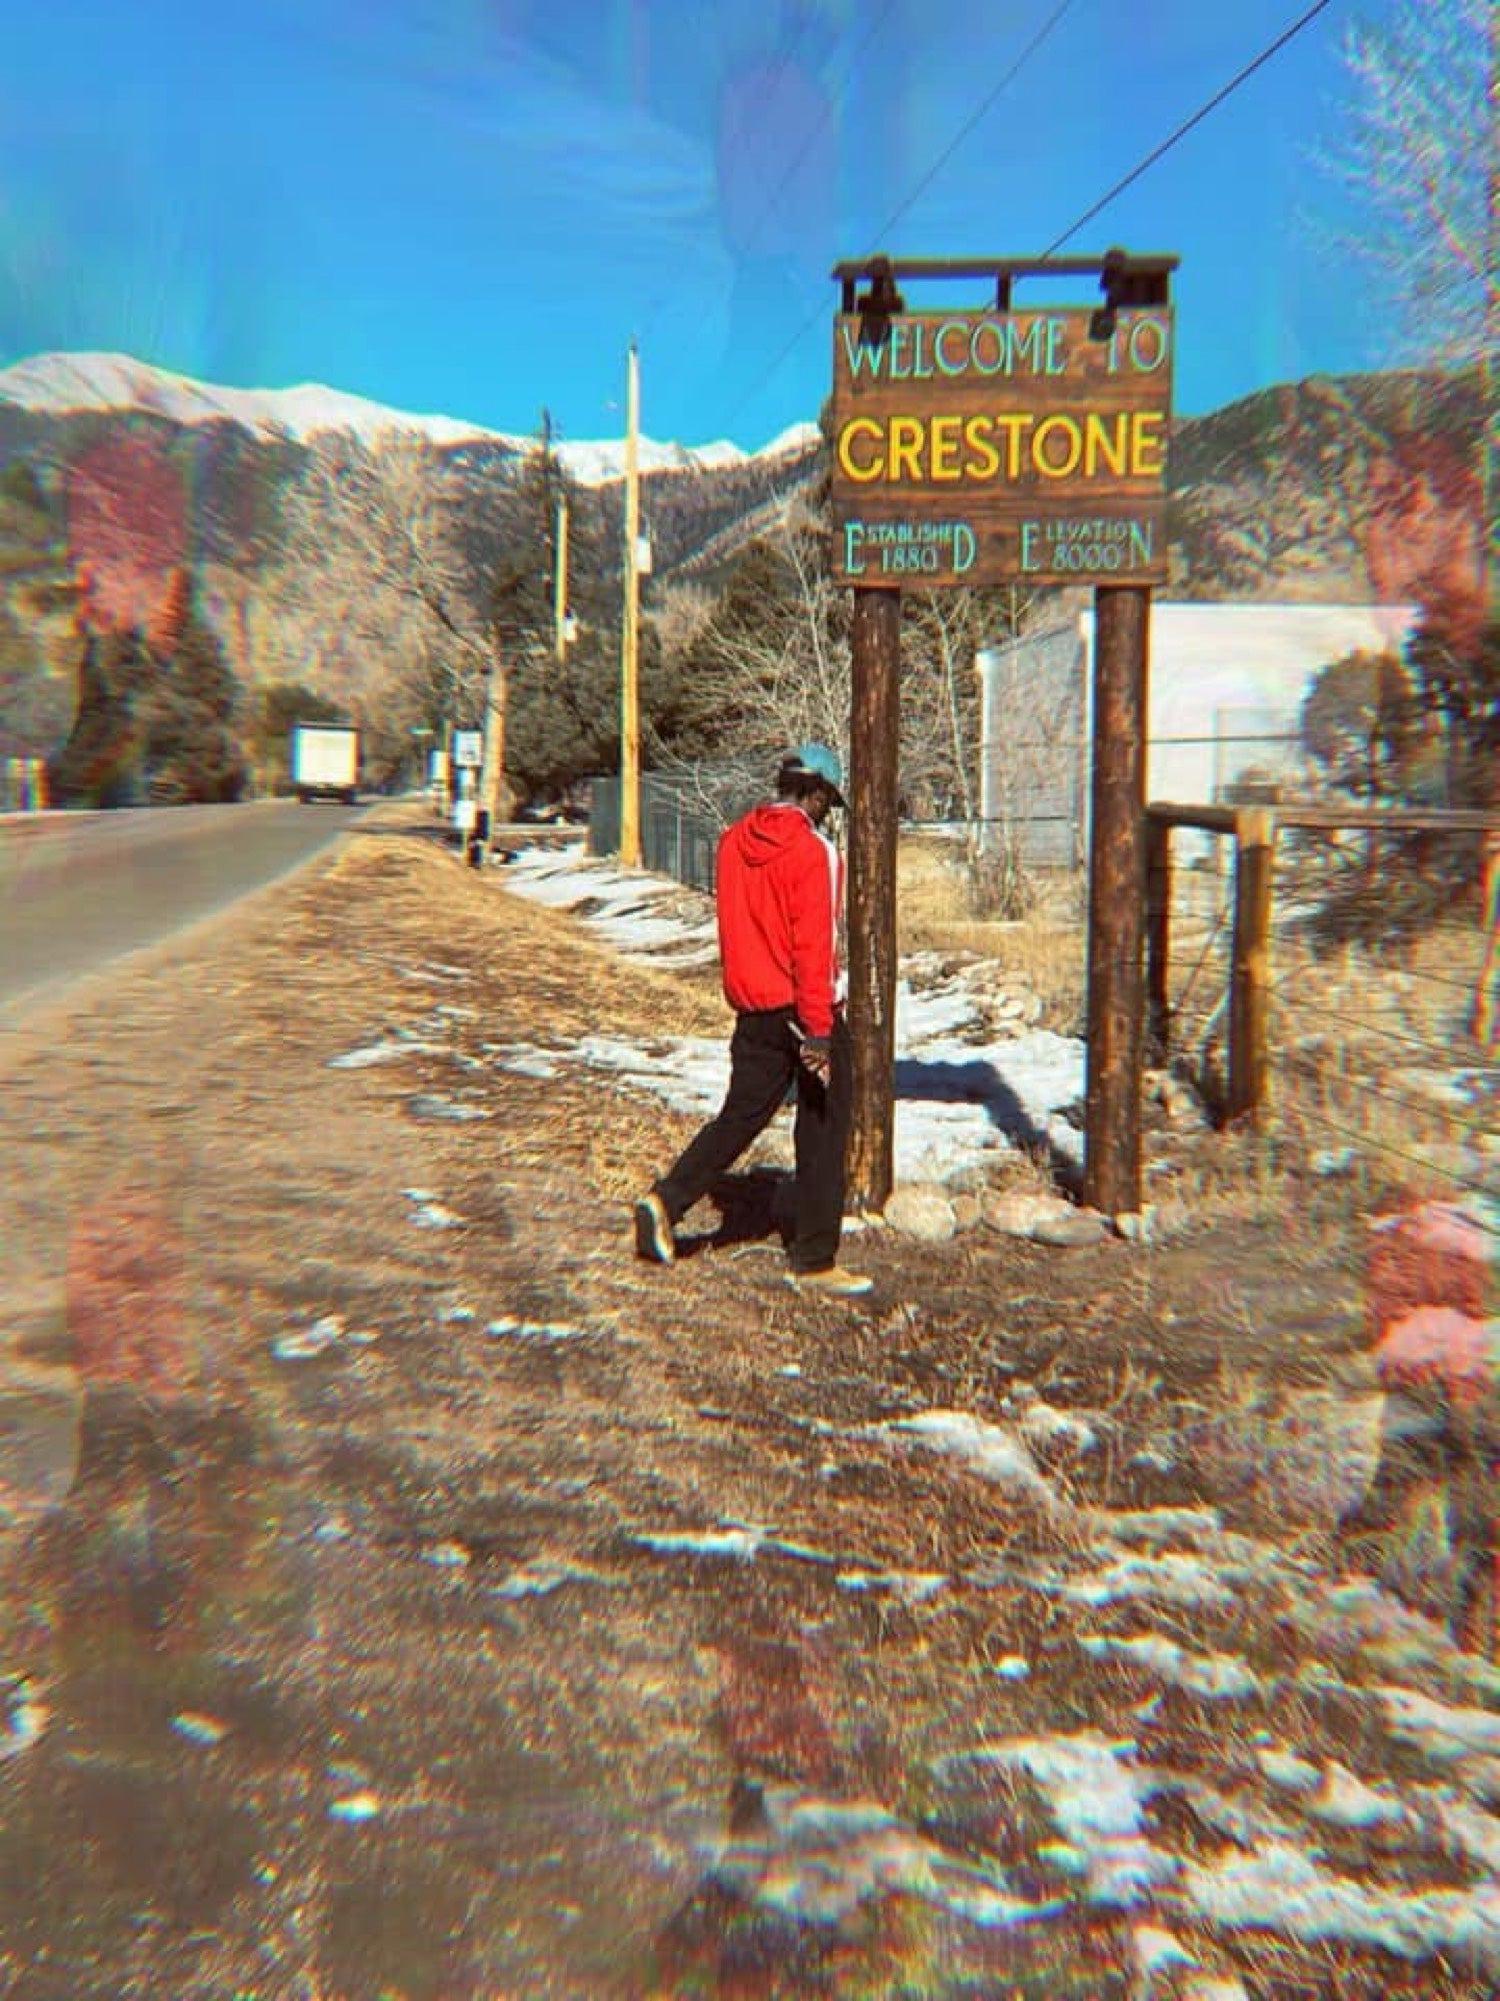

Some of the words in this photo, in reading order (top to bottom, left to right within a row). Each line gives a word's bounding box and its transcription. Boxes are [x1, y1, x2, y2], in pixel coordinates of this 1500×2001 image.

[843, 317, 1067, 378] WELCOME
[1107, 317, 1166, 374] TO
[838, 411, 1165, 482] CRESTONE
[882, 545, 939, 573] 1880
